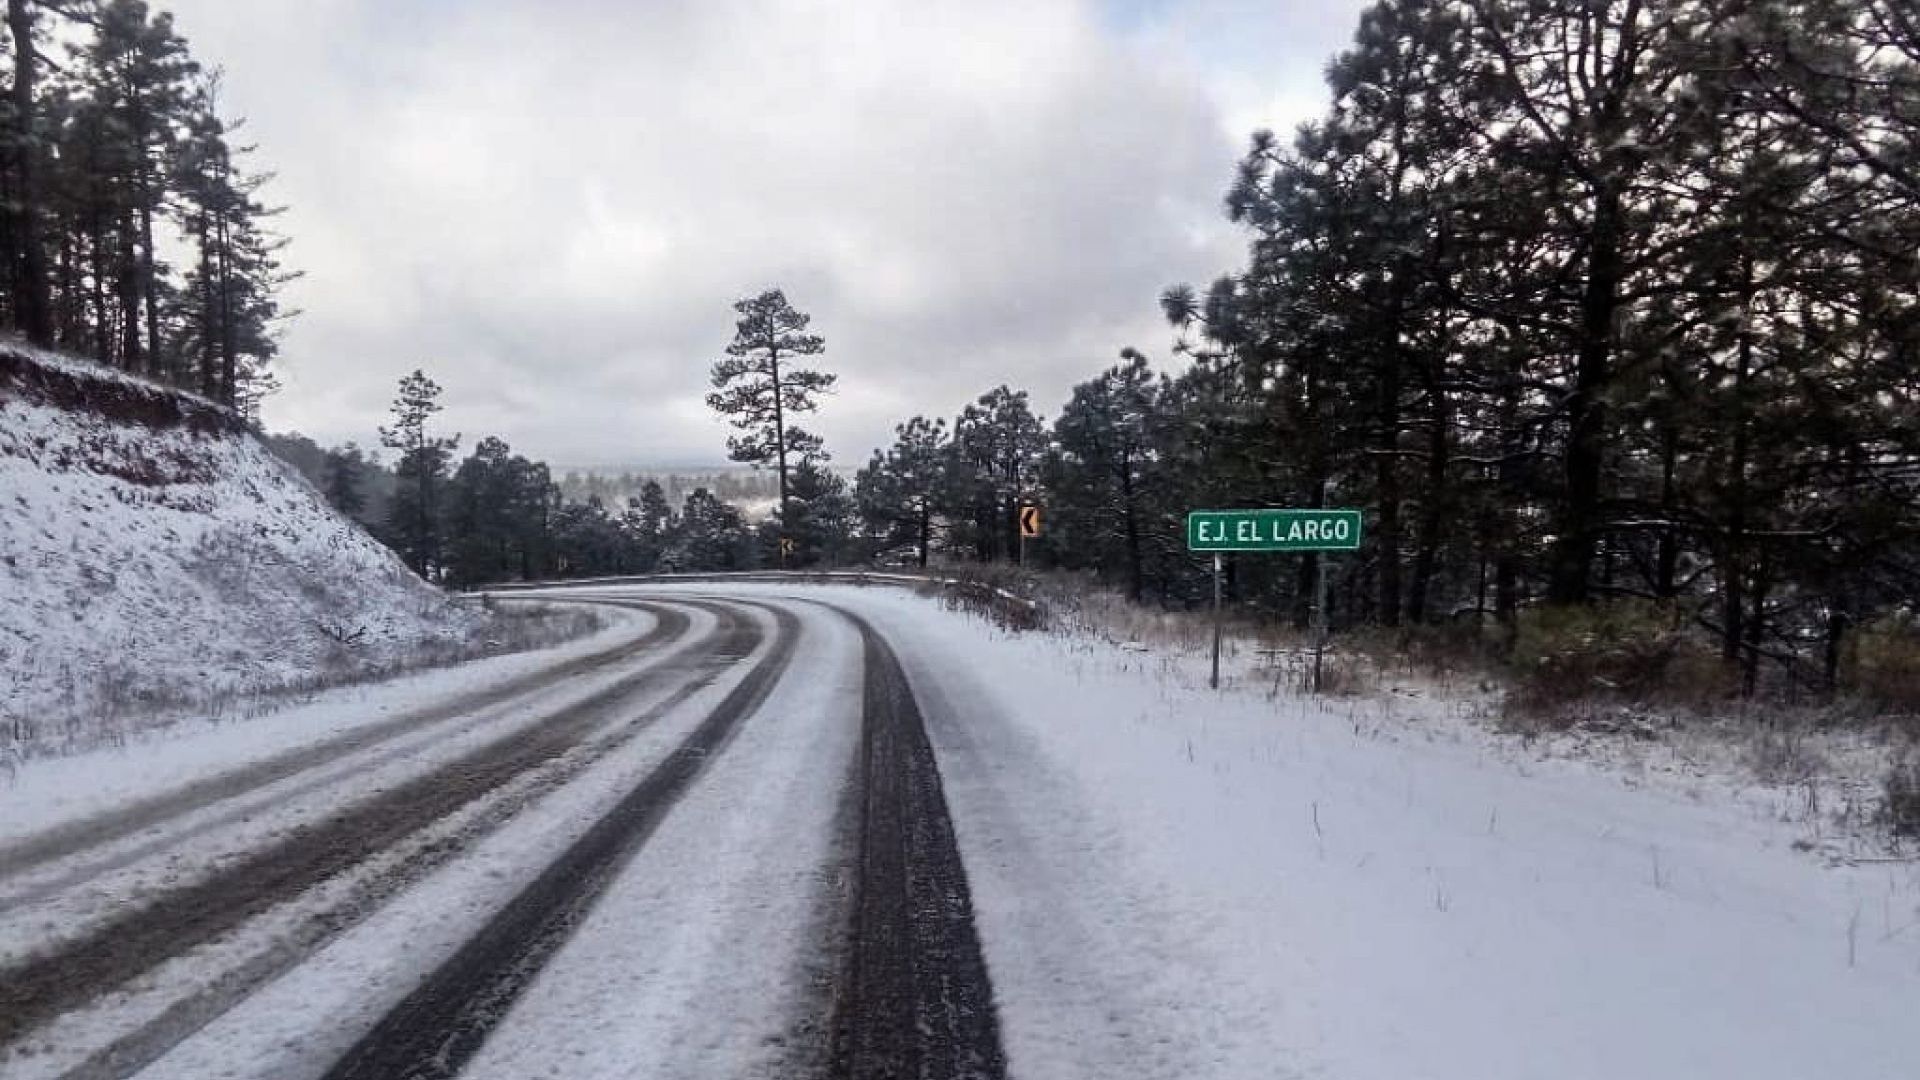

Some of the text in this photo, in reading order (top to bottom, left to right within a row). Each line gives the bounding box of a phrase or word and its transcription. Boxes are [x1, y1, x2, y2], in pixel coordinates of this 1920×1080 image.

[1198, 519, 1349, 542] EJ. EL LARGO
